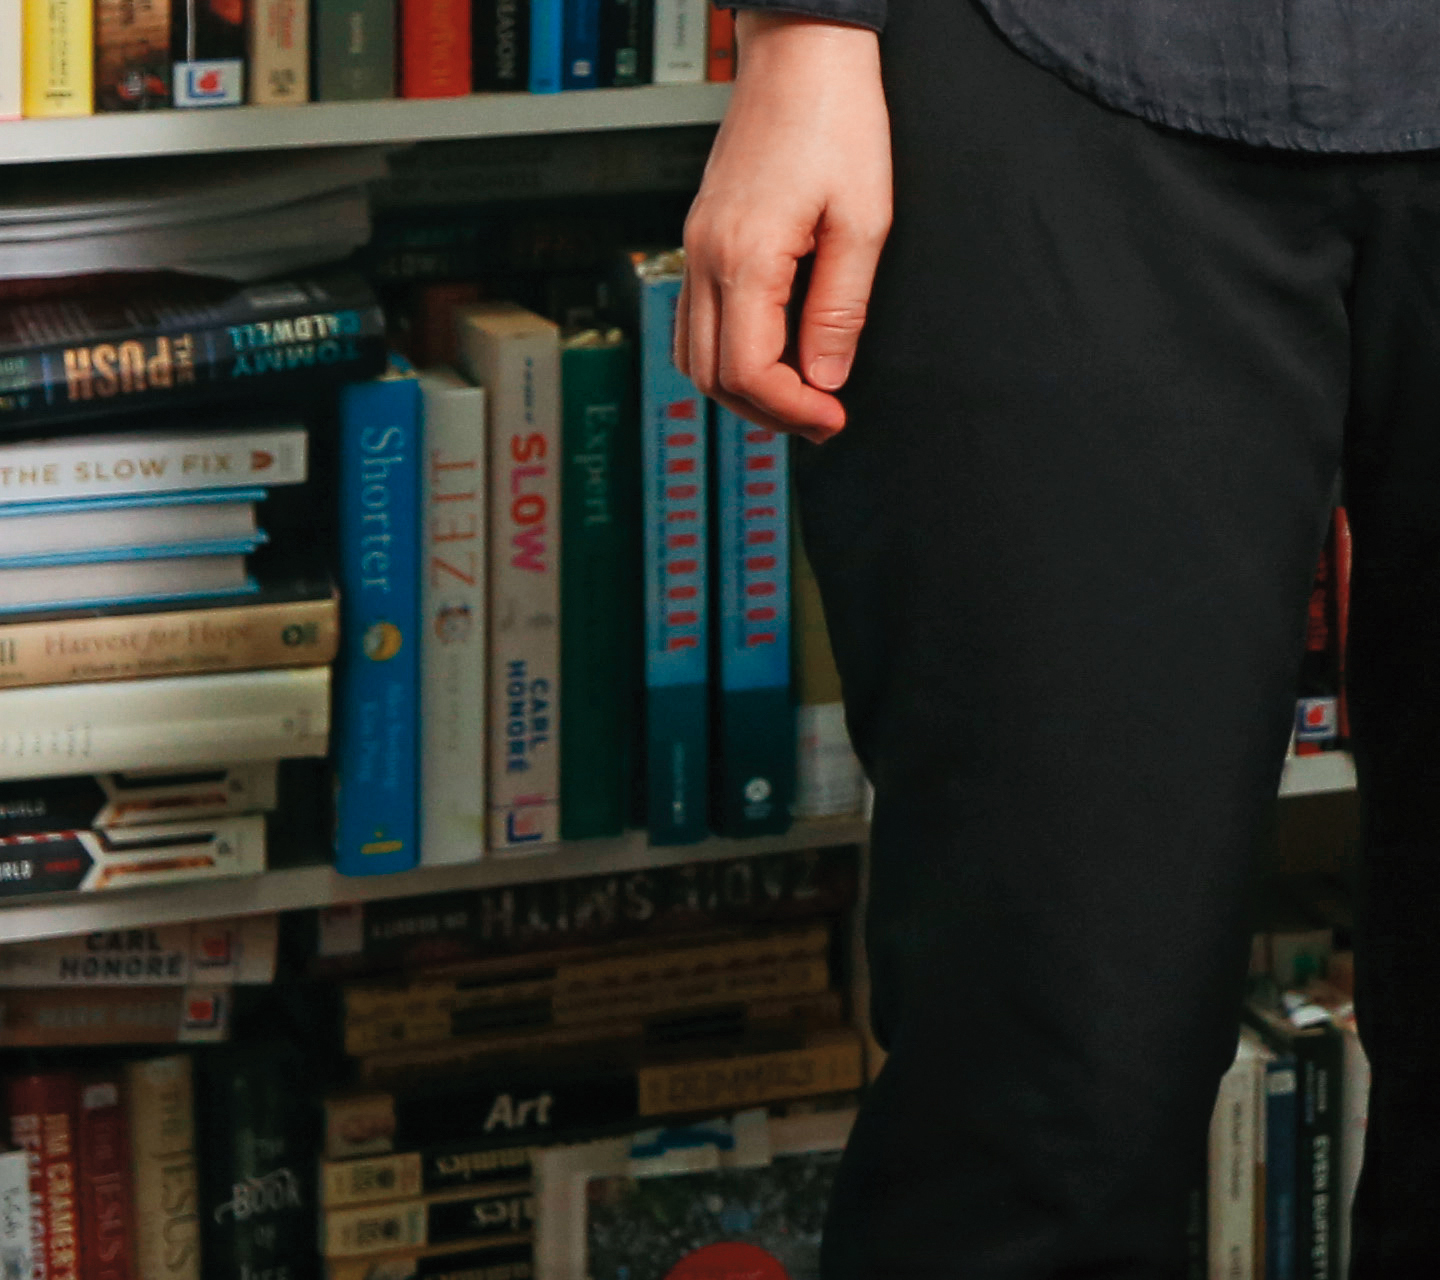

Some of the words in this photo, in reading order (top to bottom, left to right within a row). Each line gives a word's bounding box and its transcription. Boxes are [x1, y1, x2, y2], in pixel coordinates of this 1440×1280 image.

[227, 309, 363, 352] CALDWELL
[63, 335, 173, 400] PUSH
[0, 464, 60, 488] THE
[74, 456, 169, 484] SLOW
[181, 451, 235, 476] FIX
[509, 431, 549, 574] SLOW
[359, 425, 405, 592] Shorter
[430, 449, 478, 588] ZEIT
[505, 659, 529, 775] HONORÉ
[530, 677, 549, 748] CARL
[484, 1093, 553, 1132] Art
